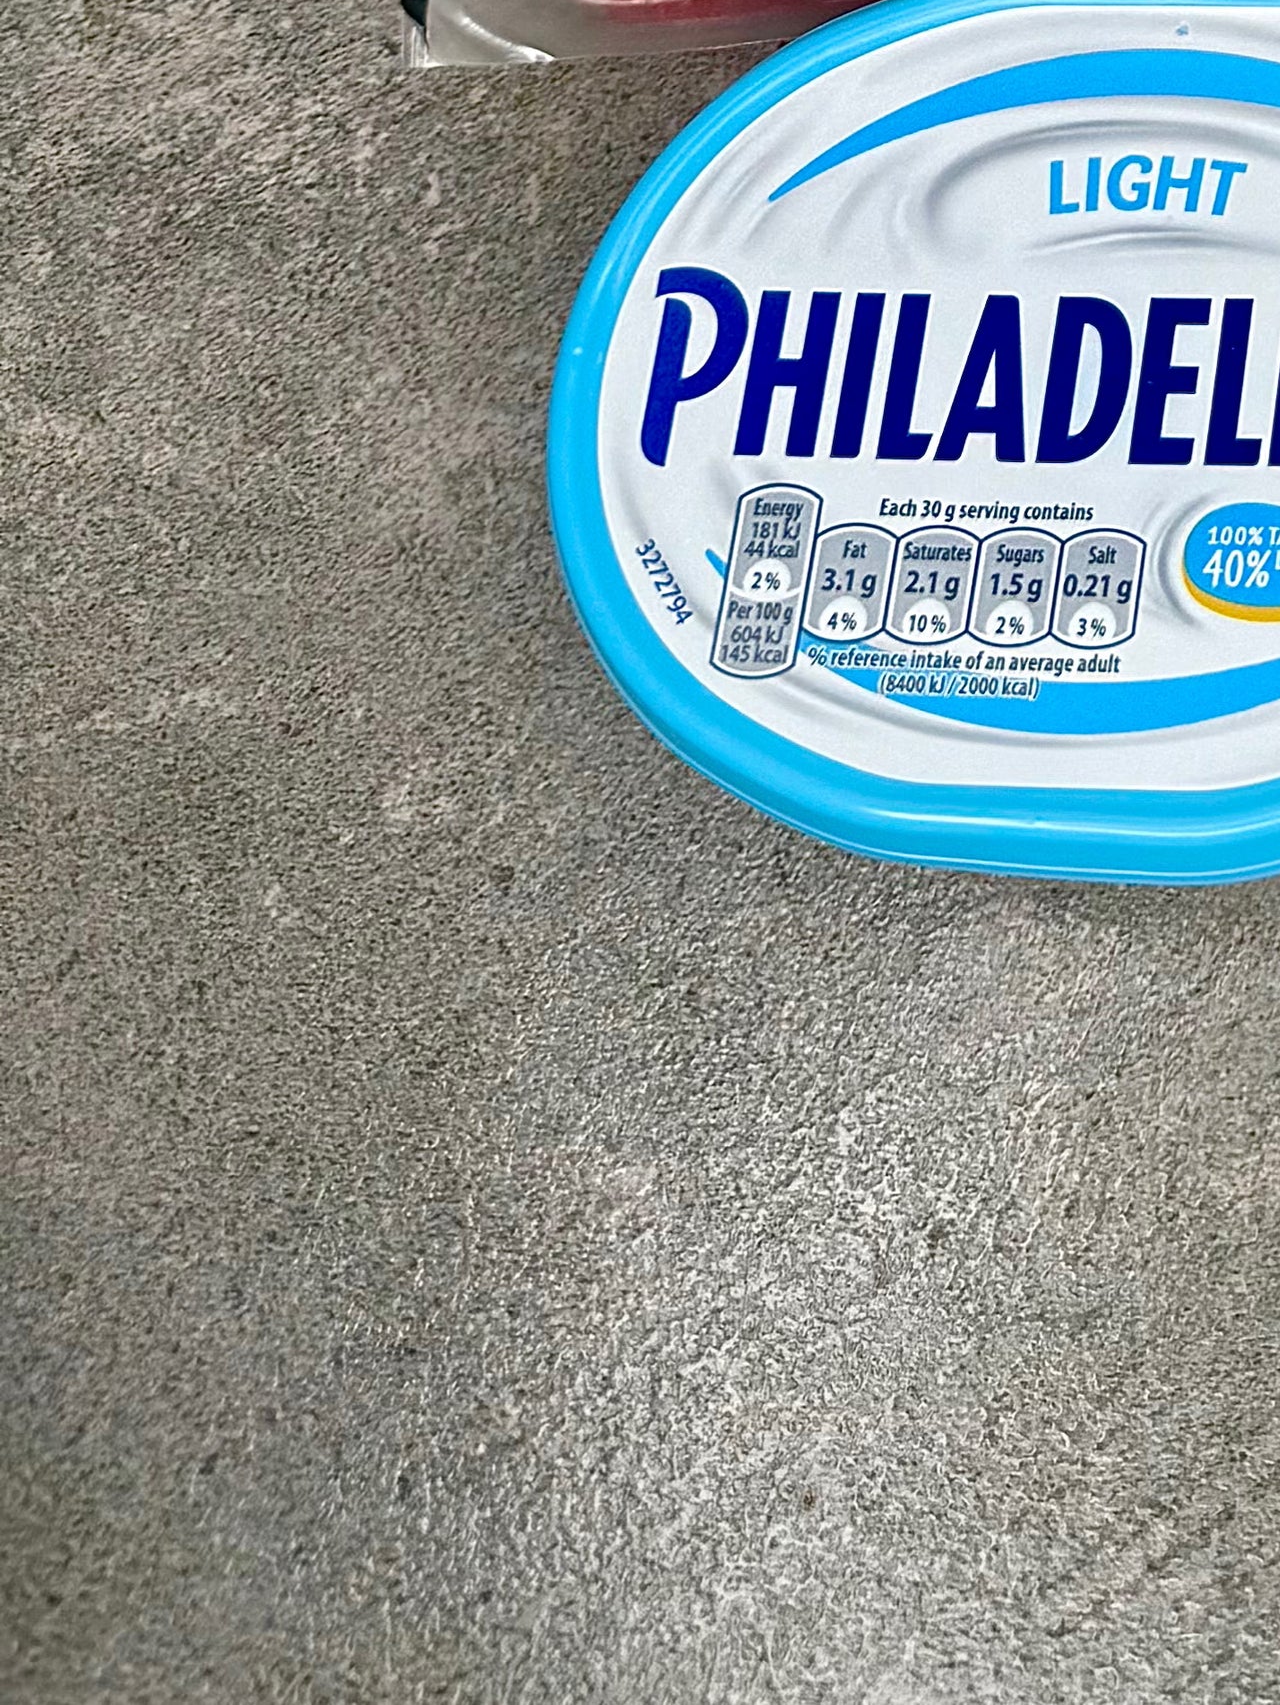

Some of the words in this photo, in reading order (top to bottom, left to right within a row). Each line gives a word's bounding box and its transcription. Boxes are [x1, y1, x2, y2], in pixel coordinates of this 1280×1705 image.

[1048, 155, 1248, 217] LIGHT
[753, 498, 804, 520] Energy
[879, 498, 917, 517] Each
[920, 501, 941, 518] 30
[959, 502, 1020, 523] serving
[1023, 504, 1094, 521] contains
[752, 522, 778, 539] 181
[1207, 526, 1264, 547] 100%
[744, 542, 765, 558] 44
[768, 541, 799, 558] kcal
[842, 540, 867, 559] Fat
[903, 542, 972, 563] Saturates
[996, 544, 1044, 567] Sugars
[1088, 545, 1116, 565] Salt
[1202, 549, 1272, 588] 40%
[635, 539, 694, 625] 3272794
[821, 569, 857, 592] 3.1
[904, 571, 939, 593] 2.1
[990, 573, 1025, 596] 1.5
[1063, 574, 1111, 598] 0.21
[727, 601, 751, 619] Per
[755, 602, 780, 621] 100
[730, 625, 761, 642] 604
[720, 645, 749, 662] 145
[753, 645, 788, 663] kcal
[830, 648, 907, 669] reference
[910, 650, 961, 670] intake
[964, 651, 983, 670] of
[986, 657, 1005, 671] an
[1007, 656, 1073, 677] average
[1078, 653, 1121, 673] adult
[879, 672, 926, 695] (8400
[1001, 675, 1041, 699] kcal)
